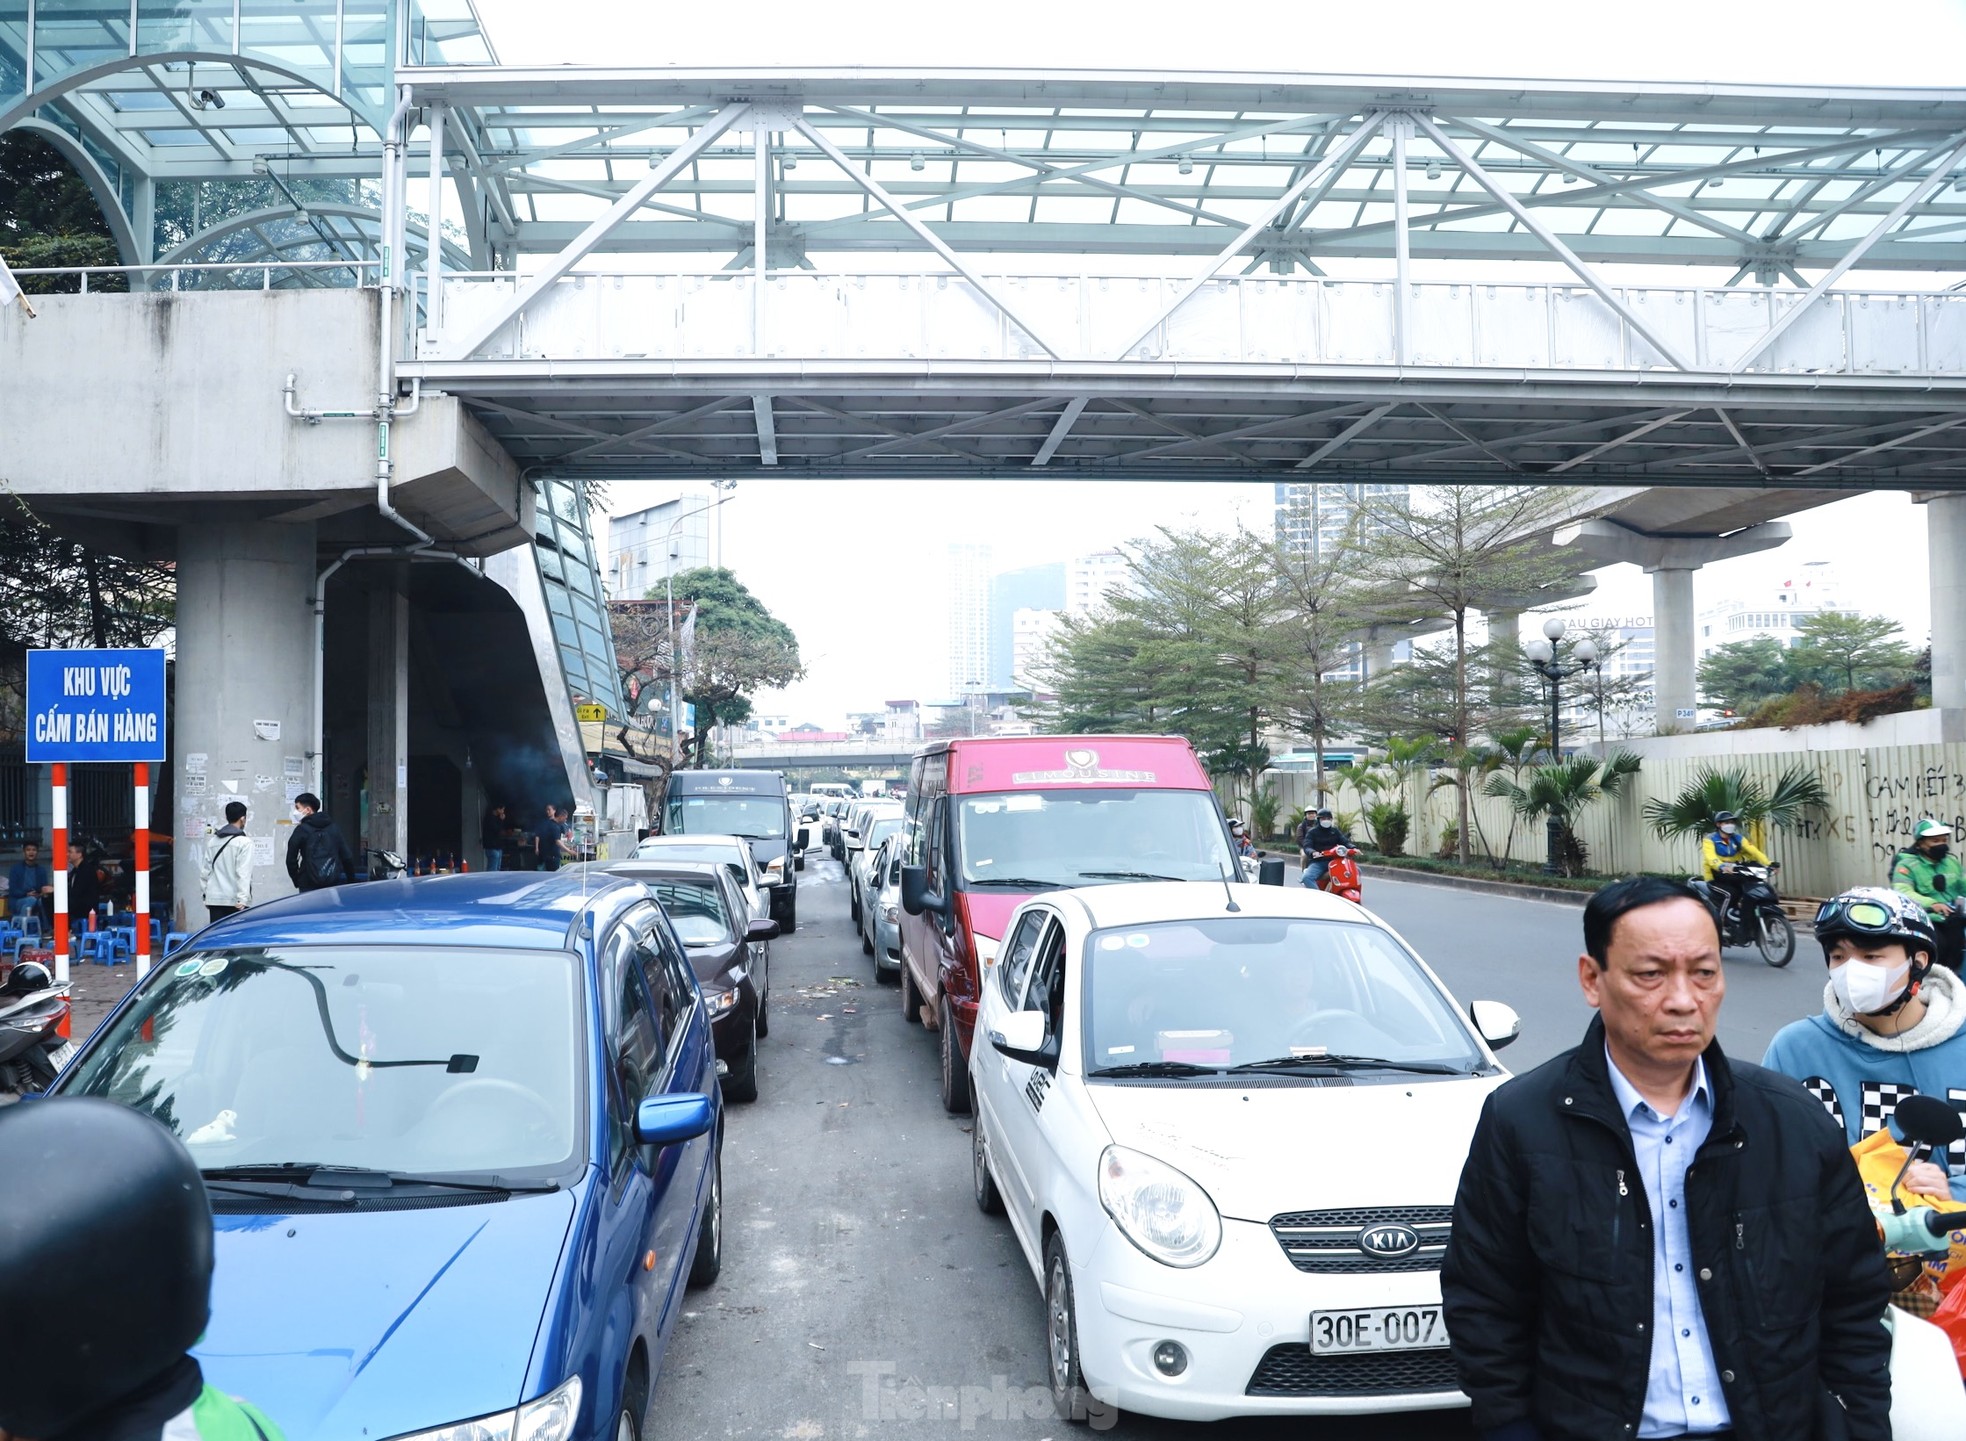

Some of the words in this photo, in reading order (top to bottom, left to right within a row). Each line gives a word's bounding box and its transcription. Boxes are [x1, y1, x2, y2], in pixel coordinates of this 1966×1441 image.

[1561, 618, 1586, 628] AU
[1590, 617, 1621, 628] GIAY
[63, 667, 96, 696] KHU
[100, 664, 131, 700] VỰC
[35, 703, 71, 742] CẤM
[75, 708, 109, 742] BÁN
[113, 707, 157, 742] HÀNG
[1014, 769, 1157, 782] LIMOUSINE
[1371, 1232, 1410, 1249] KIA
[1317, 1310, 1450, 1348] 30E-007.
